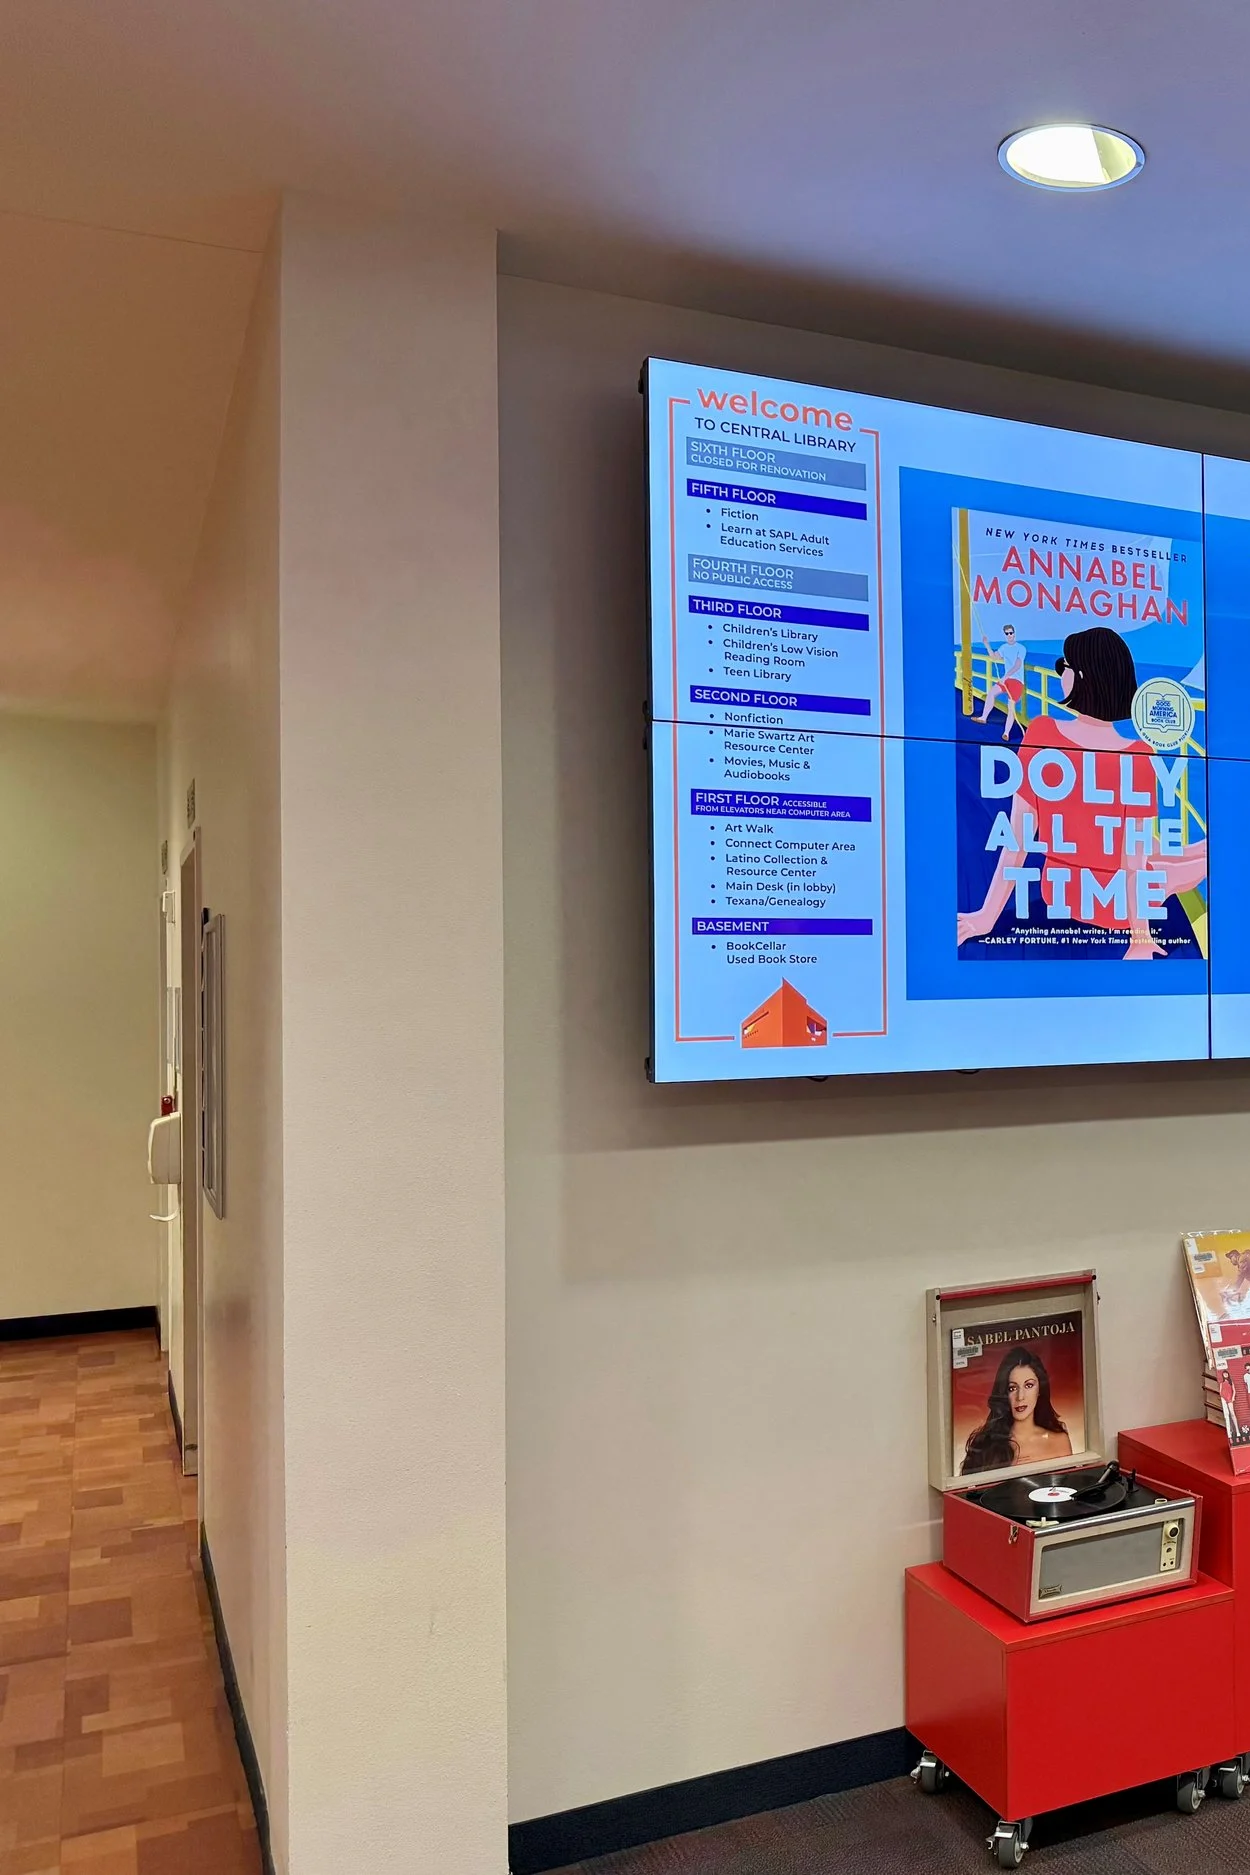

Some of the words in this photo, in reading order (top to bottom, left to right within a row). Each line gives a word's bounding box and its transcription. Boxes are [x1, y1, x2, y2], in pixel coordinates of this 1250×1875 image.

[696, 388, 854, 431] welcome
[694, 417, 716, 430] TO
[720, 421, 790, 443] CENTRAL
[794, 432, 857, 453] LIBRARY
[690, 441, 728, 456] SIXTH
[732, 448, 776, 463] FLOOR
[691, 454, 734, 468] CLOSED
[736, 460, 758, 471] FOR
[760, 463, 826, 482] RENOVATION
[691, 483, 729, 497] FIFTH
[733, 488, 776, 504] FLOOR
[721, 508, 759, 521] Fiction
[721, 523, 752, 535] Learn
[755, 527, 766, 537] at
[770, 529, 798, 542] SAPL
[800, 533, 830, 546] Adult
[720, 536, 776, 552] Education
[779, 543, 824, 557] Services
[986, 527, 1015, 539] NEW
[1024, 532, 1058, 546] YORK
[1065, 538, 1105, 551] TIMES
[1112, 544, 1188, 563] BESTSELLER
[692, 558, 747, 574] FOURTH
[751, 564, 794, 579] FLOOR
[1002, 545, 1163, 591] ANNABEL
[693, 569, 710, 580] NO
[712, 571, 750, 586] PUBLIC
[753, 576, 793, 590] ACCESS
[973, 574, 1189, 626] MONAGHAN
[693, 599, 734, 613] THIRD
[738, 603, 782, 619] FLOOR
[723, 623, 778, 638] Children's
[781, 629, 819, 643] Library
[723, 638, 779, 653] Children's
[781, 644, 803, 655] Low
[806, 645, 839, 658] Vision
[724, 652, 770, 666] Reading
[773, 655, 805, 667] Room
[724, 666, 750, 678] Teen
[753, 669, 792, 683] Library
[694, 688, 750, 703] SECOND
[754, 693, 798, 707] FLOOR
[724, 711, 784, 725] Nonfiction
[1150, 710, 1177, 718] AMERICA
[724, 728, 755, 739] Marie
[758, 730, 795, 742] Swartz
[797, 733, 815, 743] Art
[724, 741, 775, 753] Resource
[779, 745, 815, 755] Center
[724, 756, 766, 768] Movies,
[769, 759, 800, 769] Music
[803, 760, 810, 770] &
[724, 769, 791, 782] Audiobooks
[980, 744, 1188, 807] DOLLY
[695, 792, 732, 805] FIRST
[735, 794, 780, 806] FLOOR
[782, 799, 827, 809] ACCESSIBLE
[695, 805, 718, 813] FROM
[721, 805, 764, 815] ELEVATORS
[766, 808, 786, 816] NEAR
[788, 809, 829, 818] COMPUTER
[725, 824, 743, 834] Art
[745, 824, 774, 834] Walk
[984, 811, 1077, 853] ALL
[1095, 815, 1184, 856] THE
[725, 838, 772, 850] Connect
[775, 840, 829, 852] Computer
[831, 842, 856, 851] Area
[725, 854, 761, 864] Latino
[763, 855, 818, 866] Collection
[820, 857, 828, 865] &
[726, 866, 777, 877] Resource
[781, 868, 816, 878] Center
[726, 881, 753, 891] Main
[756, 882, 784, 892] Desk
[786, 883, 800, 893] (in
[803, 883, 836, 894] lobby)
[1003, 867, 1168, 921] TIME
[726, 896, 826, 908] Texana/Genealogy
[697, 921, 769, 931] BASEMENT
[1051, 927, 1081, 935] Annabel
[726, 941, 786, 951] BookCellar
[1019, 937, 1059, 945] FORTUNE,
[726, 954, 755, 964] Used
[758, 954, 786, 964] Book
[789, 954, 817, 964] Store
[967, 1331, 1012, 1346] SABEL
[1015, 1321, 1075, 1340] PANTOJA
